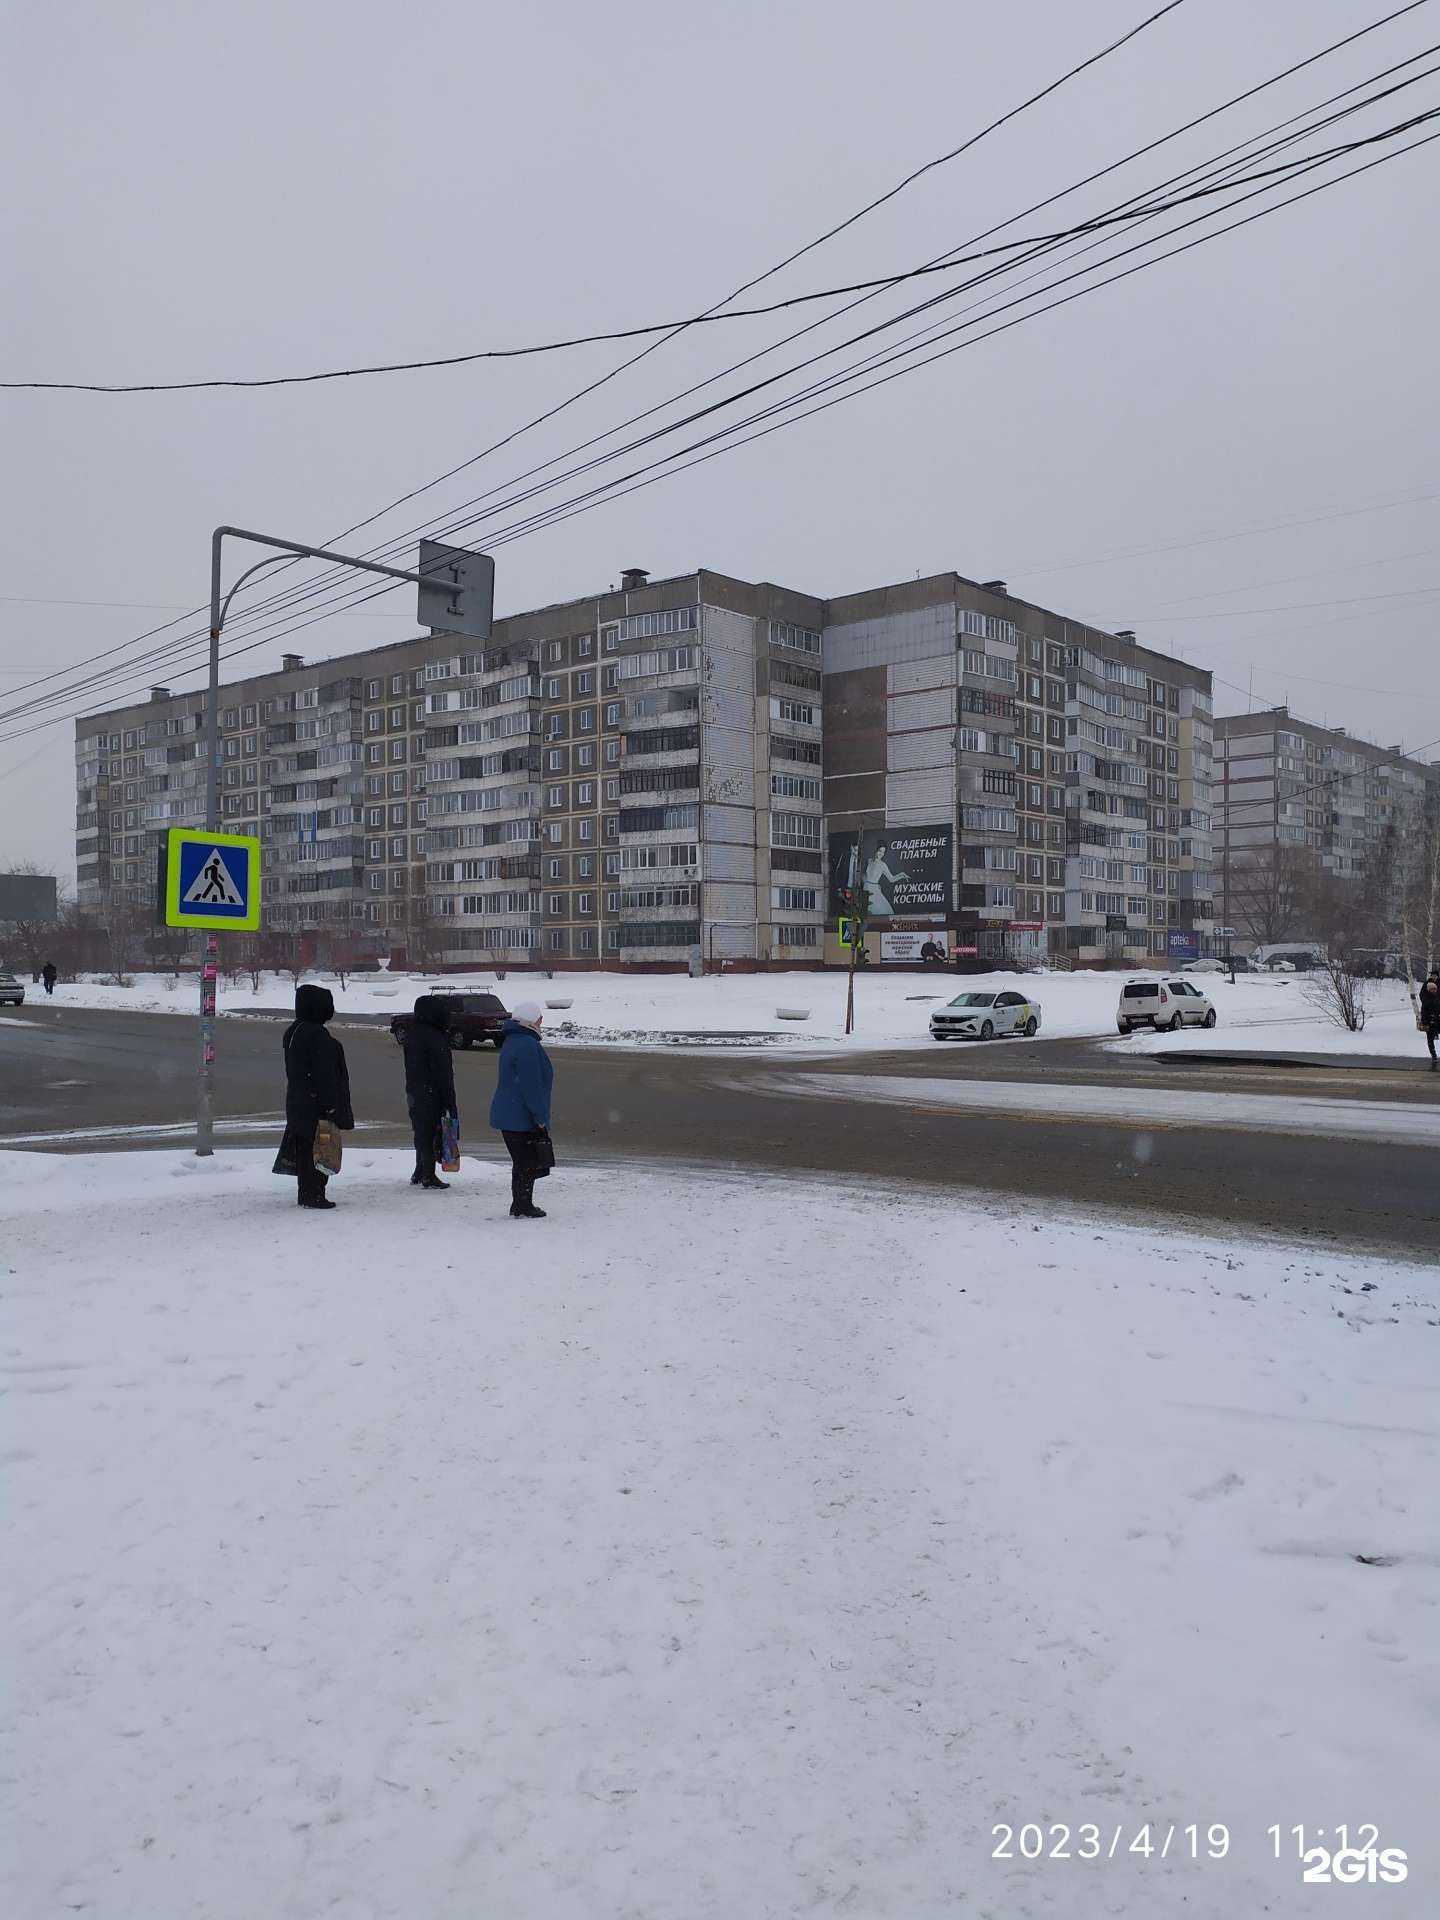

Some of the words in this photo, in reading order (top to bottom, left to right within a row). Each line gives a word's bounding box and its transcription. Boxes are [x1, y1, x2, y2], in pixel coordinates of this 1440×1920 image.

[890, 837, 948, 850] СВАДЕБНЫЕ
[900, 848, 938, 860] ПЛАТЬЯ
[893, 881, 944, 894] МУЖСКИЕ
[893, 893, 945, 905] КОСТЮМЫ
